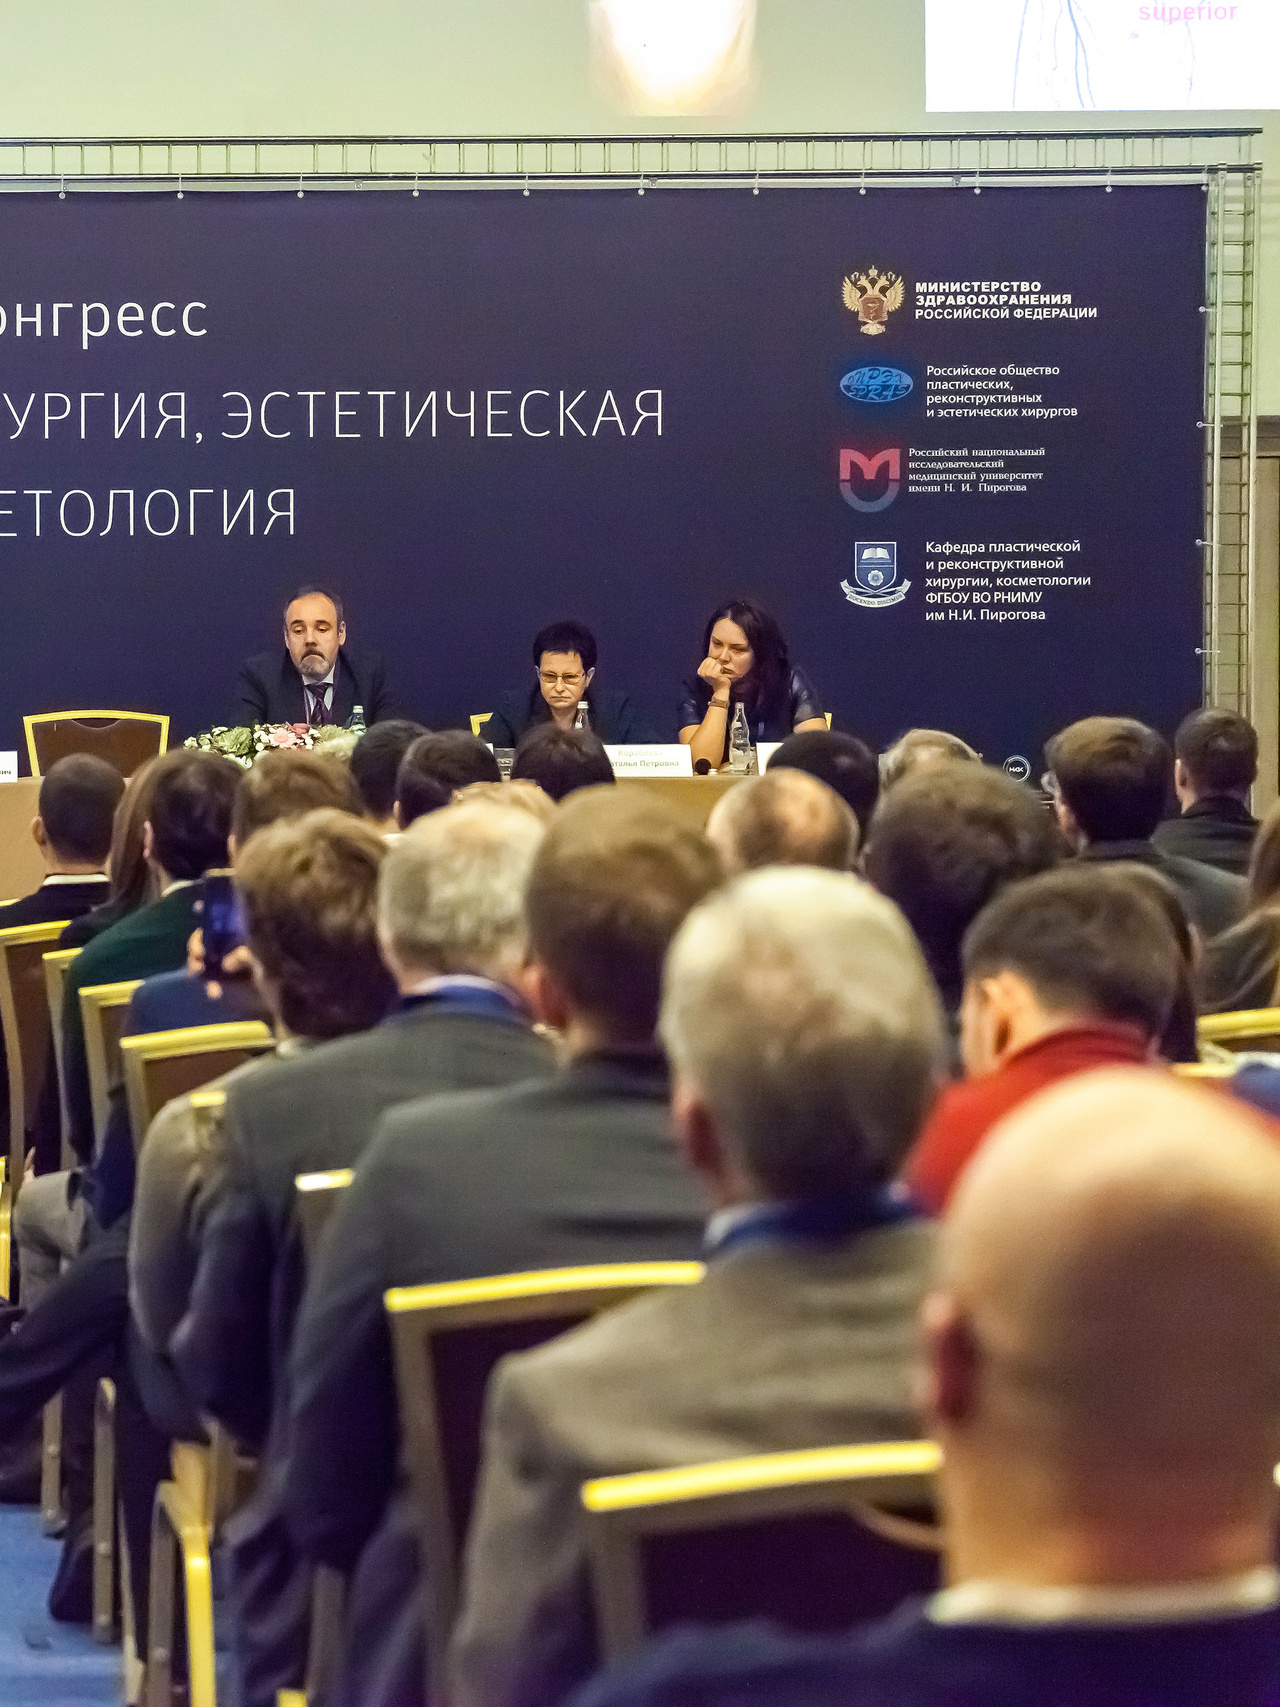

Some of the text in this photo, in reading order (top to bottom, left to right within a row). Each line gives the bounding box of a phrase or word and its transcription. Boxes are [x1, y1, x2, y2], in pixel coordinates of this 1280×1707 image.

[1138, 1, 1239, 25] superior
[915, 281, 1042, 293] МИНИСТЕРСТВО
[915, 293, 1072, 309] ЗДРАВООХРАНЕНИЯ
[915, 306, 1098, 321] РОССИЙСКОЙ ФЕДЕРАЦИИ
[926, 363, 1060, 377] Российское общество
[926, 380, 1014, 391] пластических,
[926, 394, 1043, 406] реконструктивных
[221, 389, 662, 439] ЭСТЕТИЧЕСКАЯ
[926, 407, 1078, 420] и эстетических хирургов
[908, 447, 1046, 459] Российский национальный
[908, 461, 1004, 470] исследовательский
[908, 472, 1044, 485] медицинский университет
[944, 483, 956, 493] Н.
[961, 483, 973, 493] И.
[978, 482, 1027, 494] Пирогова
[926, 539, 1081, 556] Кафедра пластической
[925, 556, 1064, 573] и реконструктивной
[925, 576, 1091, 590] хирургии, косметологии
[925, 591, 1043, 604] ФГБОУ ВО РНИМУ
[925, 608, 1046, 623] им Н.И. Пирогова
[610, 759, 680, 768] аталья Петровна
